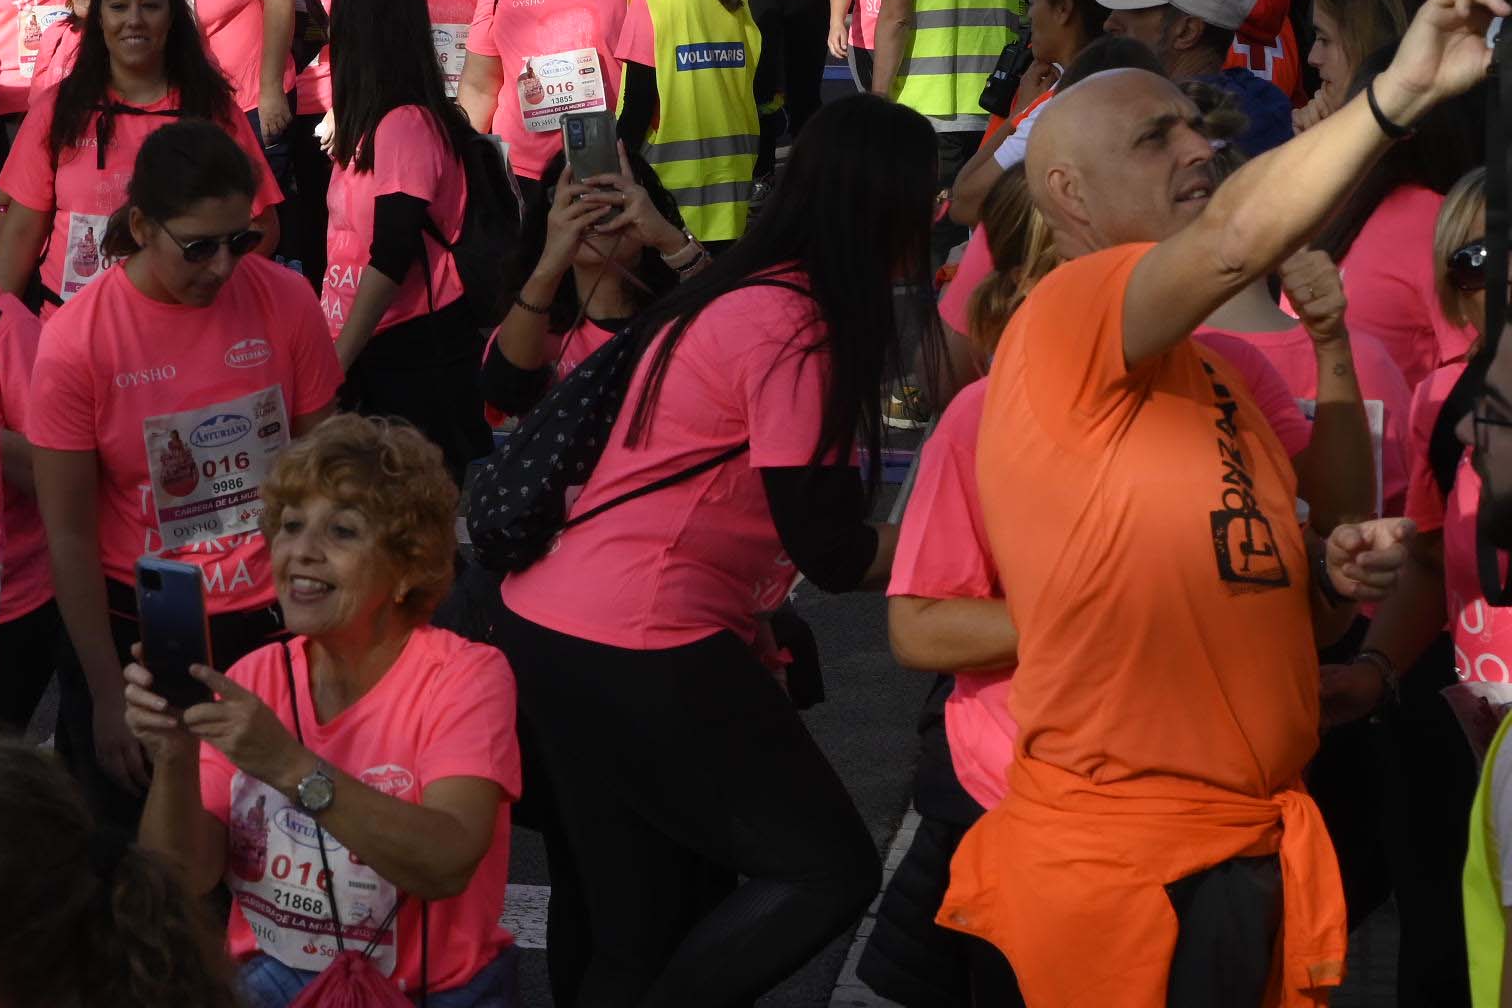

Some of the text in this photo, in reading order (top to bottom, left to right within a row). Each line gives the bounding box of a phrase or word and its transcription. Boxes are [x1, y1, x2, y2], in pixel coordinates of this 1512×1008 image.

[678, 48, 745, 67] VOLUNTARIS
[546, 81, 575, 95] 016
[551, 95, 573, 104] 13855
[116, 364, 177, 389] OYSHO
[195, 424, 249, 444] ASTURIANA
[202, 451, 250, 478] 016
[213, 478, 244, 494] 9986
[175, 503, 214, 518] CARRERA
[215, 499, 227, 508] DE
[228, 496, 239, 505] LA
[173, 520, 218, 537] OYSHO
[271, 854, 335, 891] 016
[273, 888, 323, 915] 21868
[276, 913, 289, 924] DE
[292, 917, 307, 928] LA
